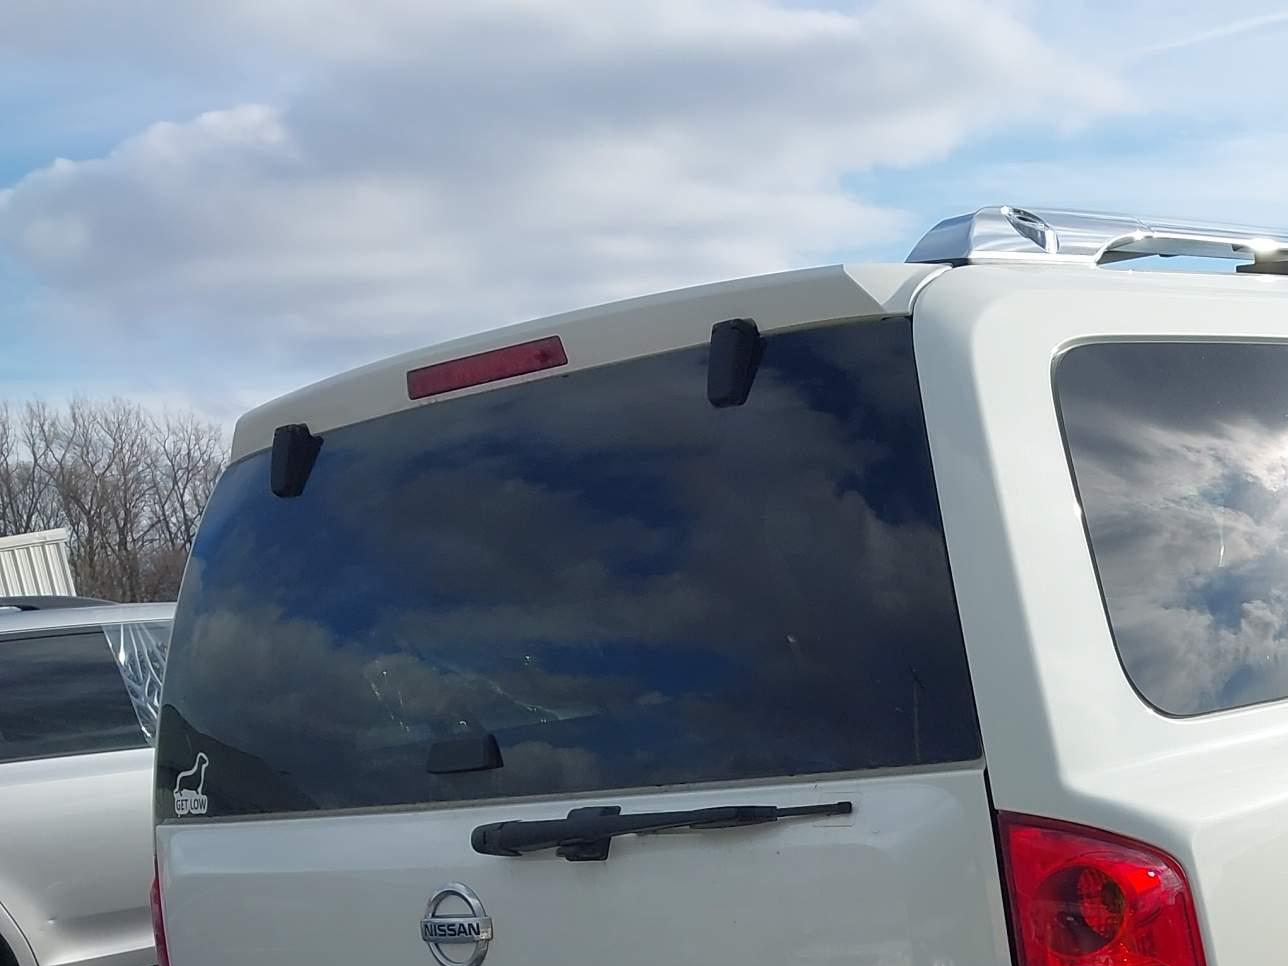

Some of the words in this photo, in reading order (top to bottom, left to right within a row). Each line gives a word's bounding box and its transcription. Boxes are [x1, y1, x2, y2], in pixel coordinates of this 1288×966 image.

[176, 799, 188, 811] GET
[190, 798, 207, 811] LOW
[424, 922, 481, 937] NISSAN
